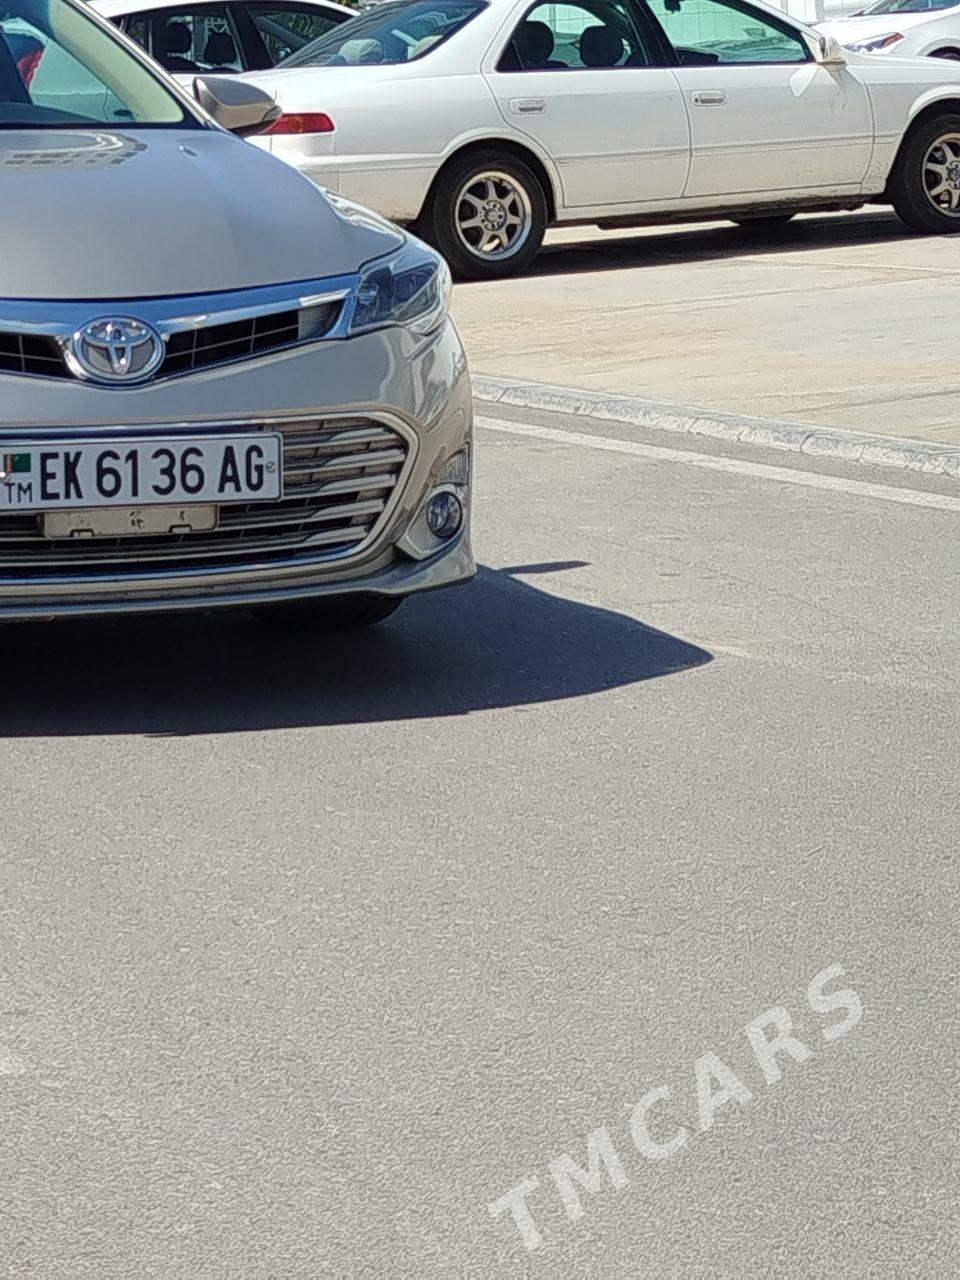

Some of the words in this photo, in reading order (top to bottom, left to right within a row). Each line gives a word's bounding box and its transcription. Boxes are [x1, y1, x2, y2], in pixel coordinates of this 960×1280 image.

[3, 481, 33, 504] TM
[40, 451, 83, 501] EK
[218, 444, 264, 493] AG
